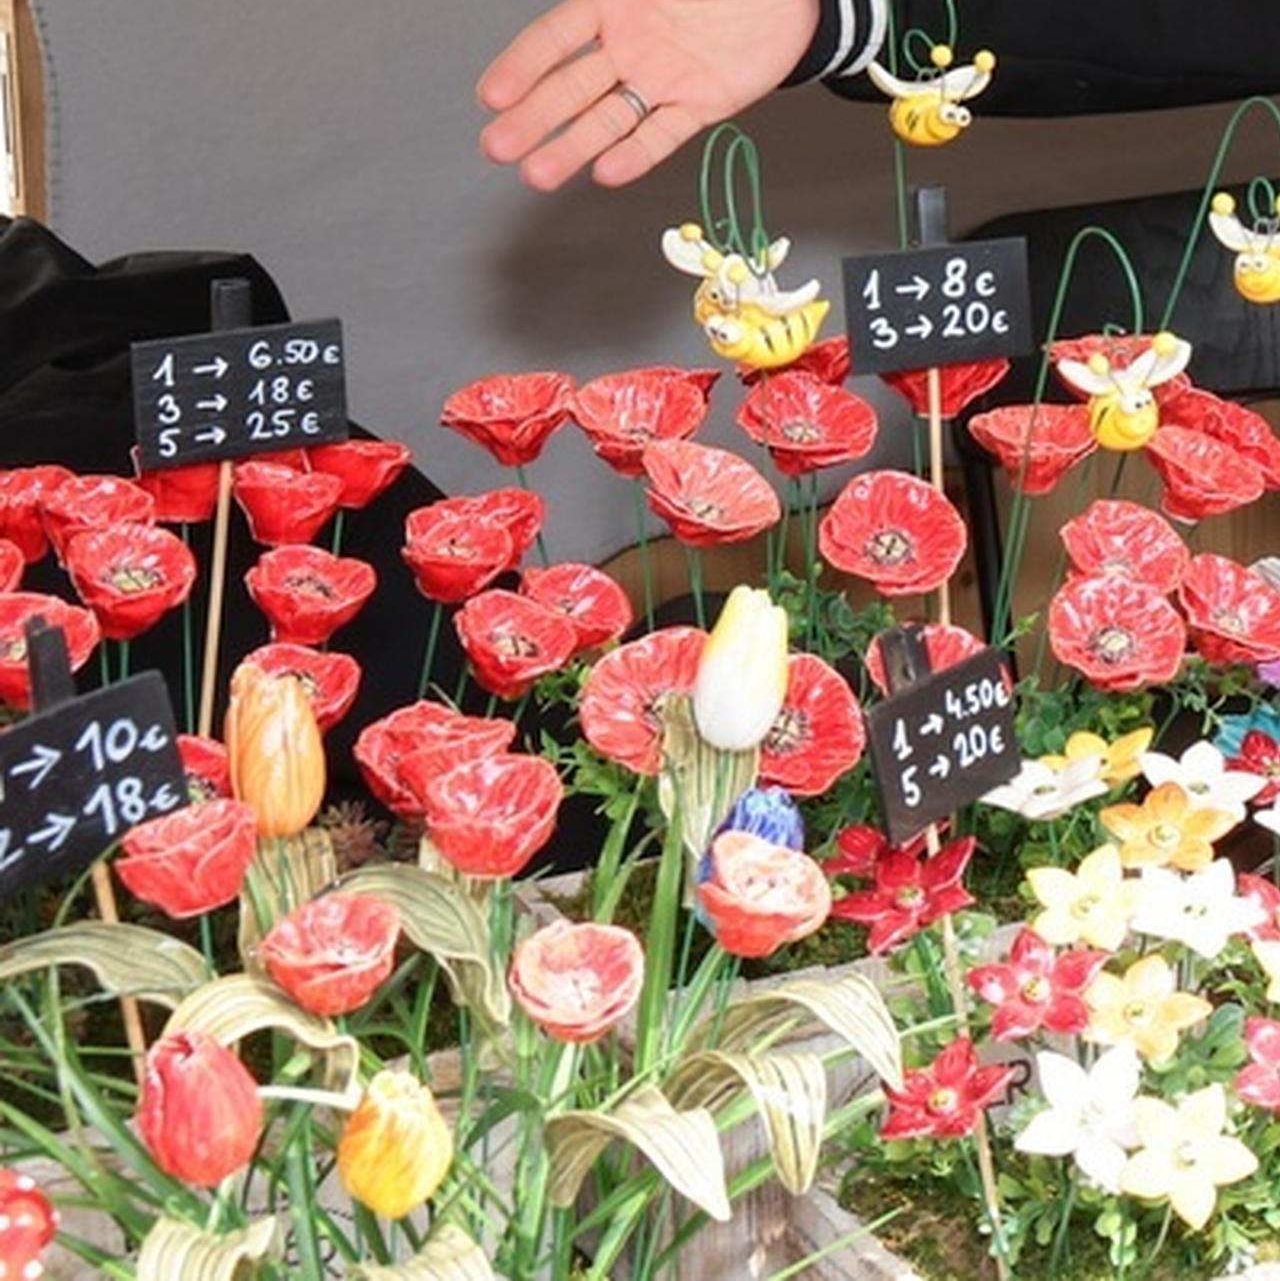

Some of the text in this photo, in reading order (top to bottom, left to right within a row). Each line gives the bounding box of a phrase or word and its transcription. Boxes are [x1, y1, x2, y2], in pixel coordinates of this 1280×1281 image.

[862, 258, 997, 310] 1 8€
[869, 302, 1010, 349] 3 20€
[152, 339, 341, 388] 1 6.50€
[158, 377, 314, 424] 3 18€
[158, 410, 322, 458] 5 25€
[75, 719, 169, 773] 10€
[892, 679, 1012, 761] 1 4.50€
[900, 724, 1006, 807] 5 20€
[83, 776, 181, 835] 18€
